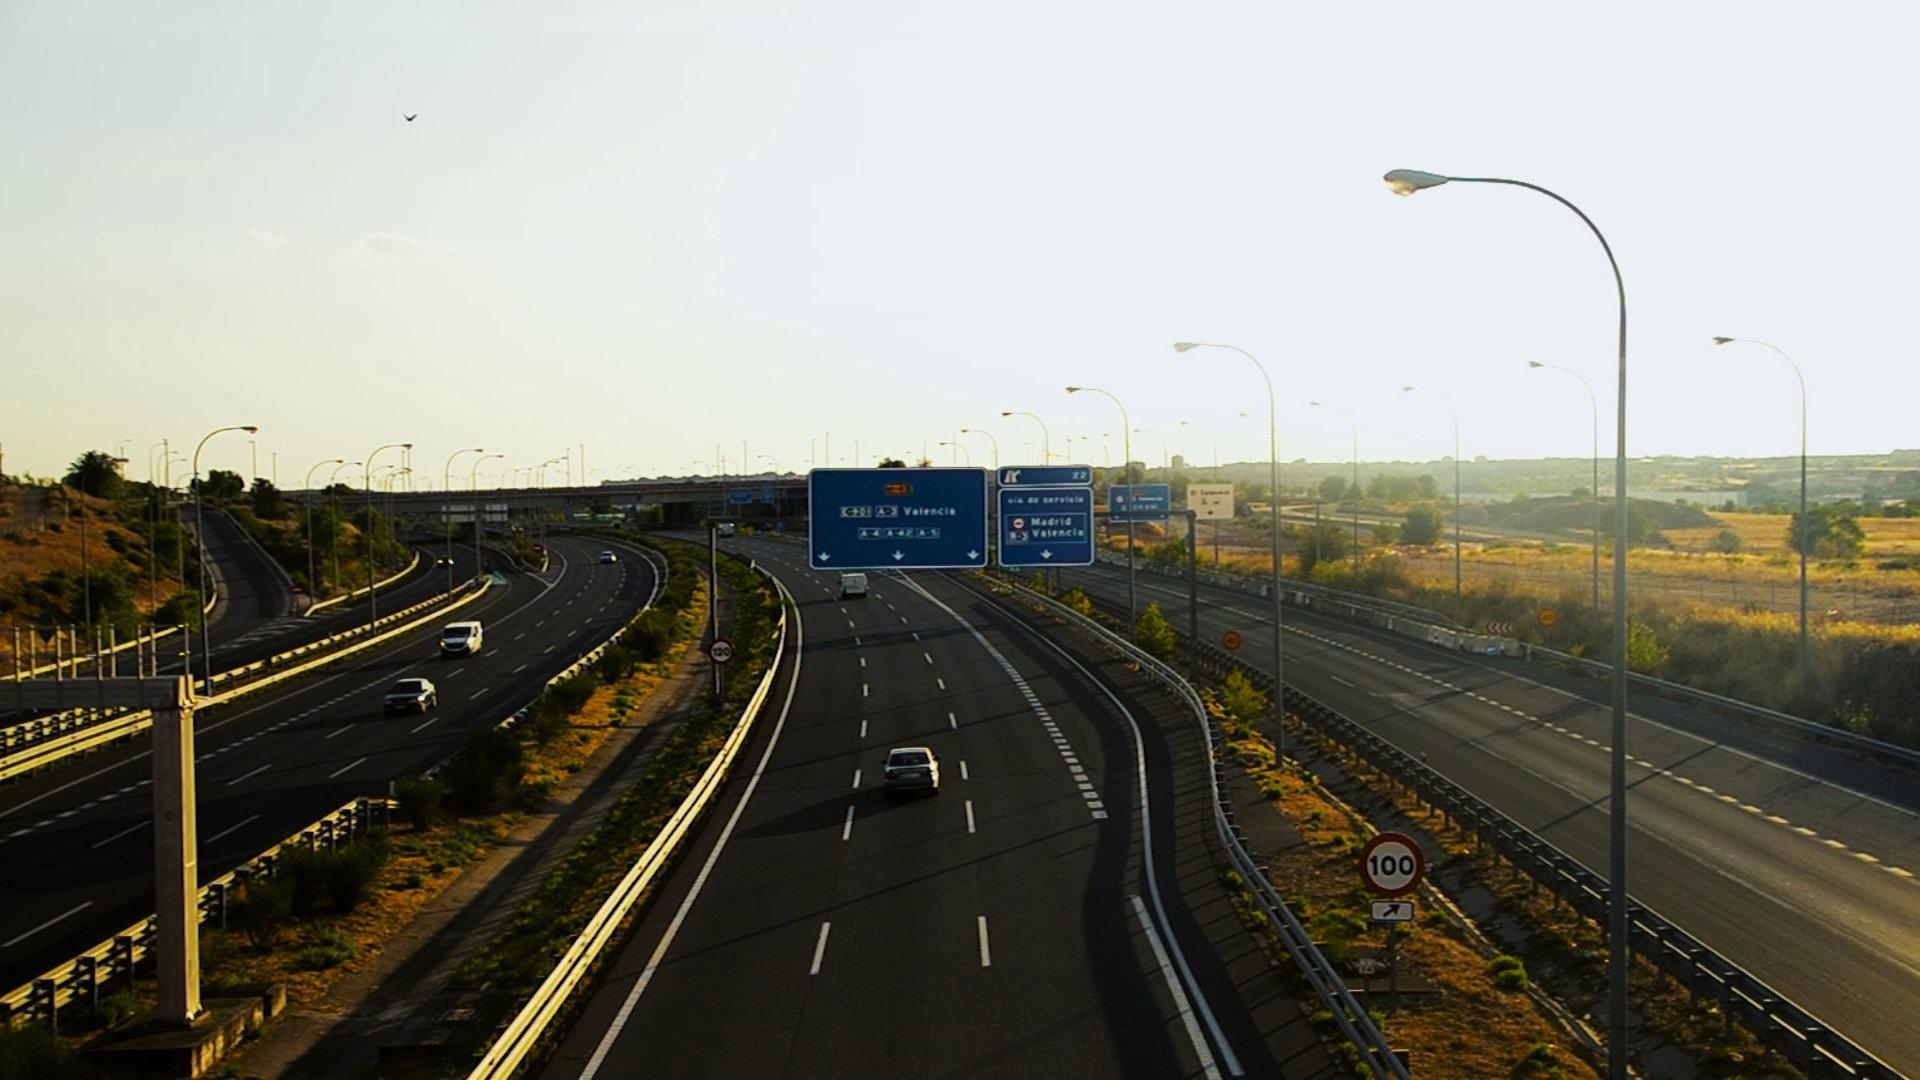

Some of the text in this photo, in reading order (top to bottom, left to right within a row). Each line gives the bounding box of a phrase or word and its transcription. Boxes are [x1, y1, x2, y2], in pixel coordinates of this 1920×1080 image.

[903, 506, 957, 516] Valencia
[1030, 516, 1072, 526] Madrid
[1032, 527, 1084, 538] Valencia
[1370, 855, 1414, 876] 100
